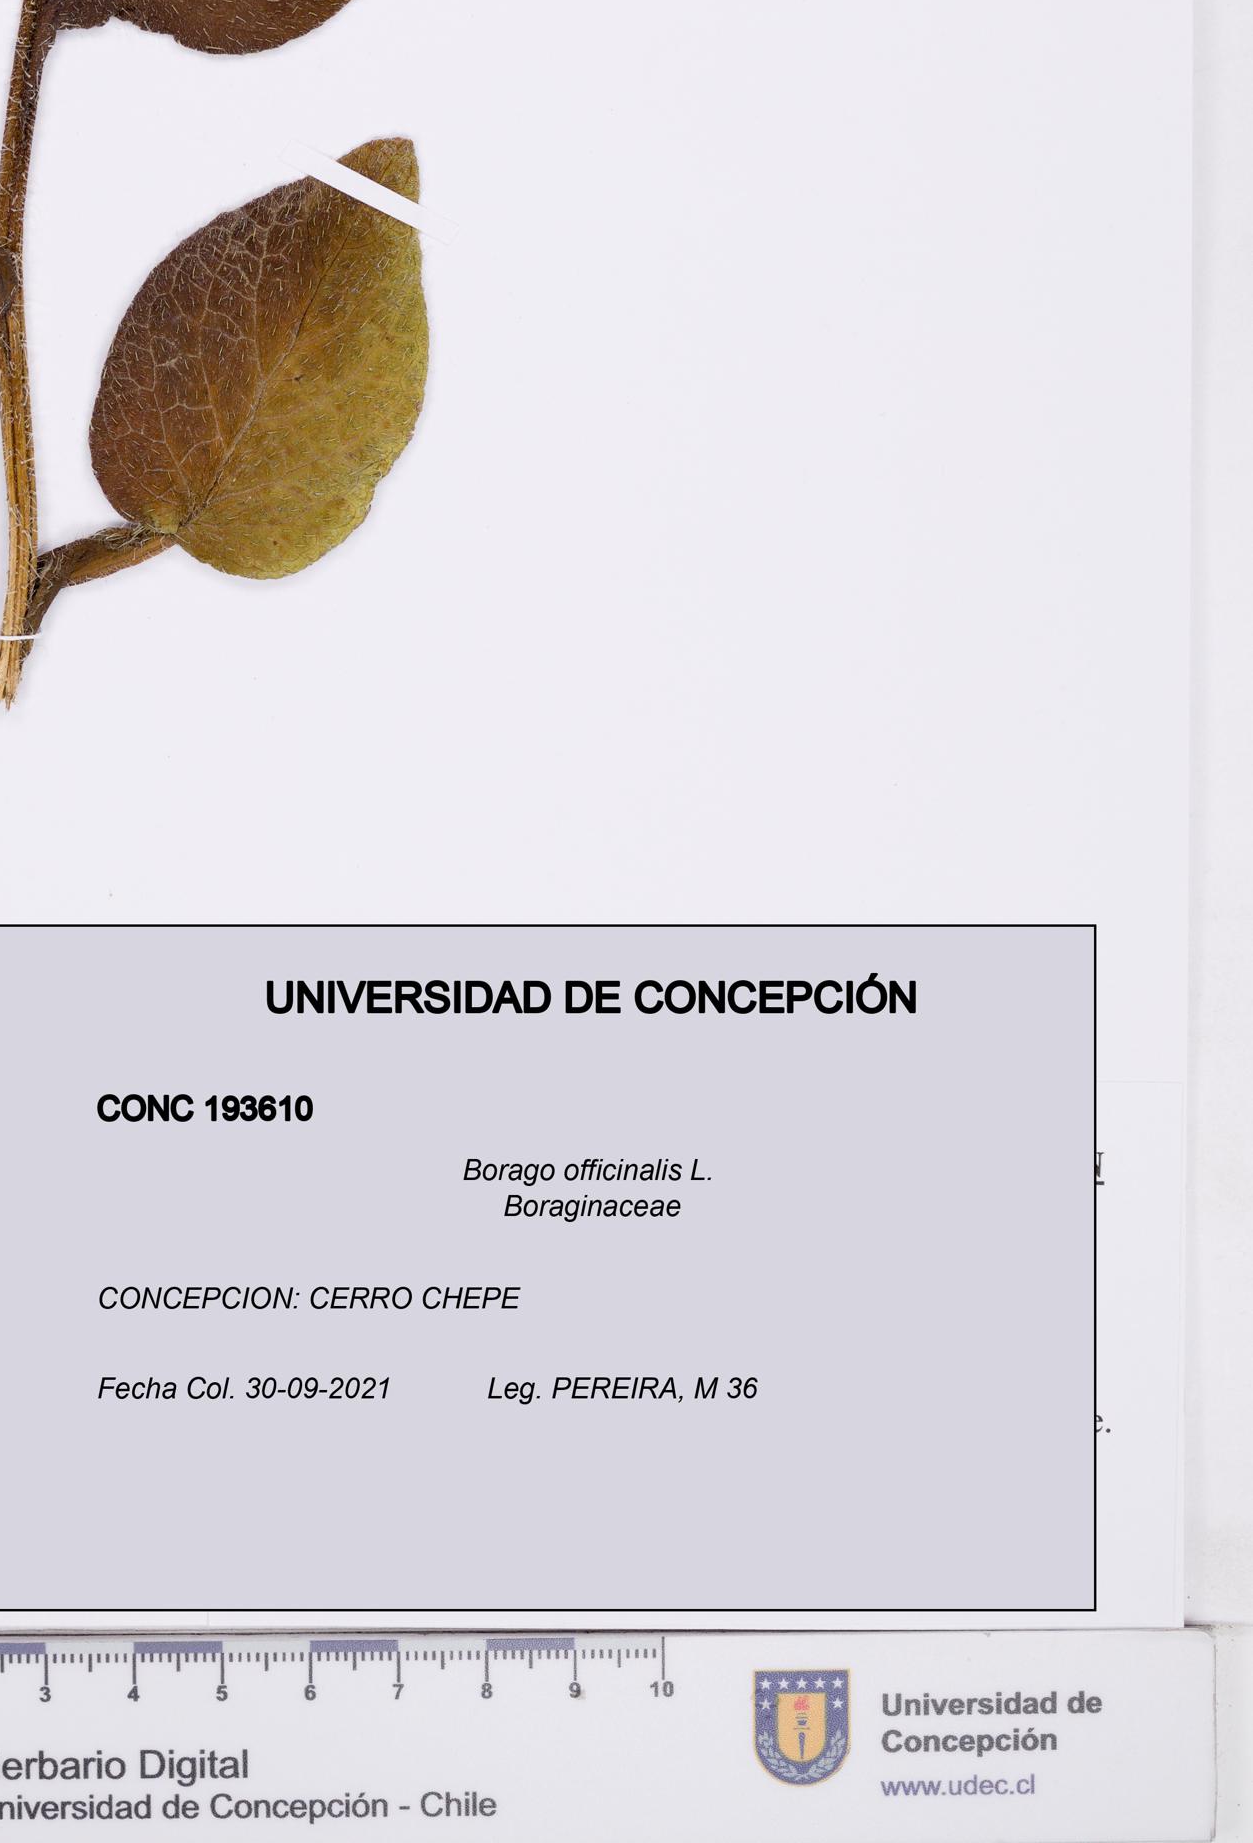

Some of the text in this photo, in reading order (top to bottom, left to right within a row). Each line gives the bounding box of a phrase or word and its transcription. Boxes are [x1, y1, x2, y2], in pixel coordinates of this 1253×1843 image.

[38, 1687, 52, 1703] 3
[126, 1686, 141, 1703] 4
[215, 1685, 229, 1702] 5
[303, 1685, 317, 1702] 6
[392, 1684, 405, 1701] 7
[480, 1683, 494, 1700] 8
[568, 1683, 582, 1700] 9
[650, 1681, 675, 1699] 10
[882, 1690, 1103, 1717] Universidad de
[881, 1727, 1058, 1758] Concepción
[139, 1748, 249, 1785] Digital
[880, 1773, 1036, 1798] www.udec.cl
[161, 1792, 200, 1820] de
[209, 1791, 389, 1826] Concepción
[420, 1790, 498, 1818] Chile
